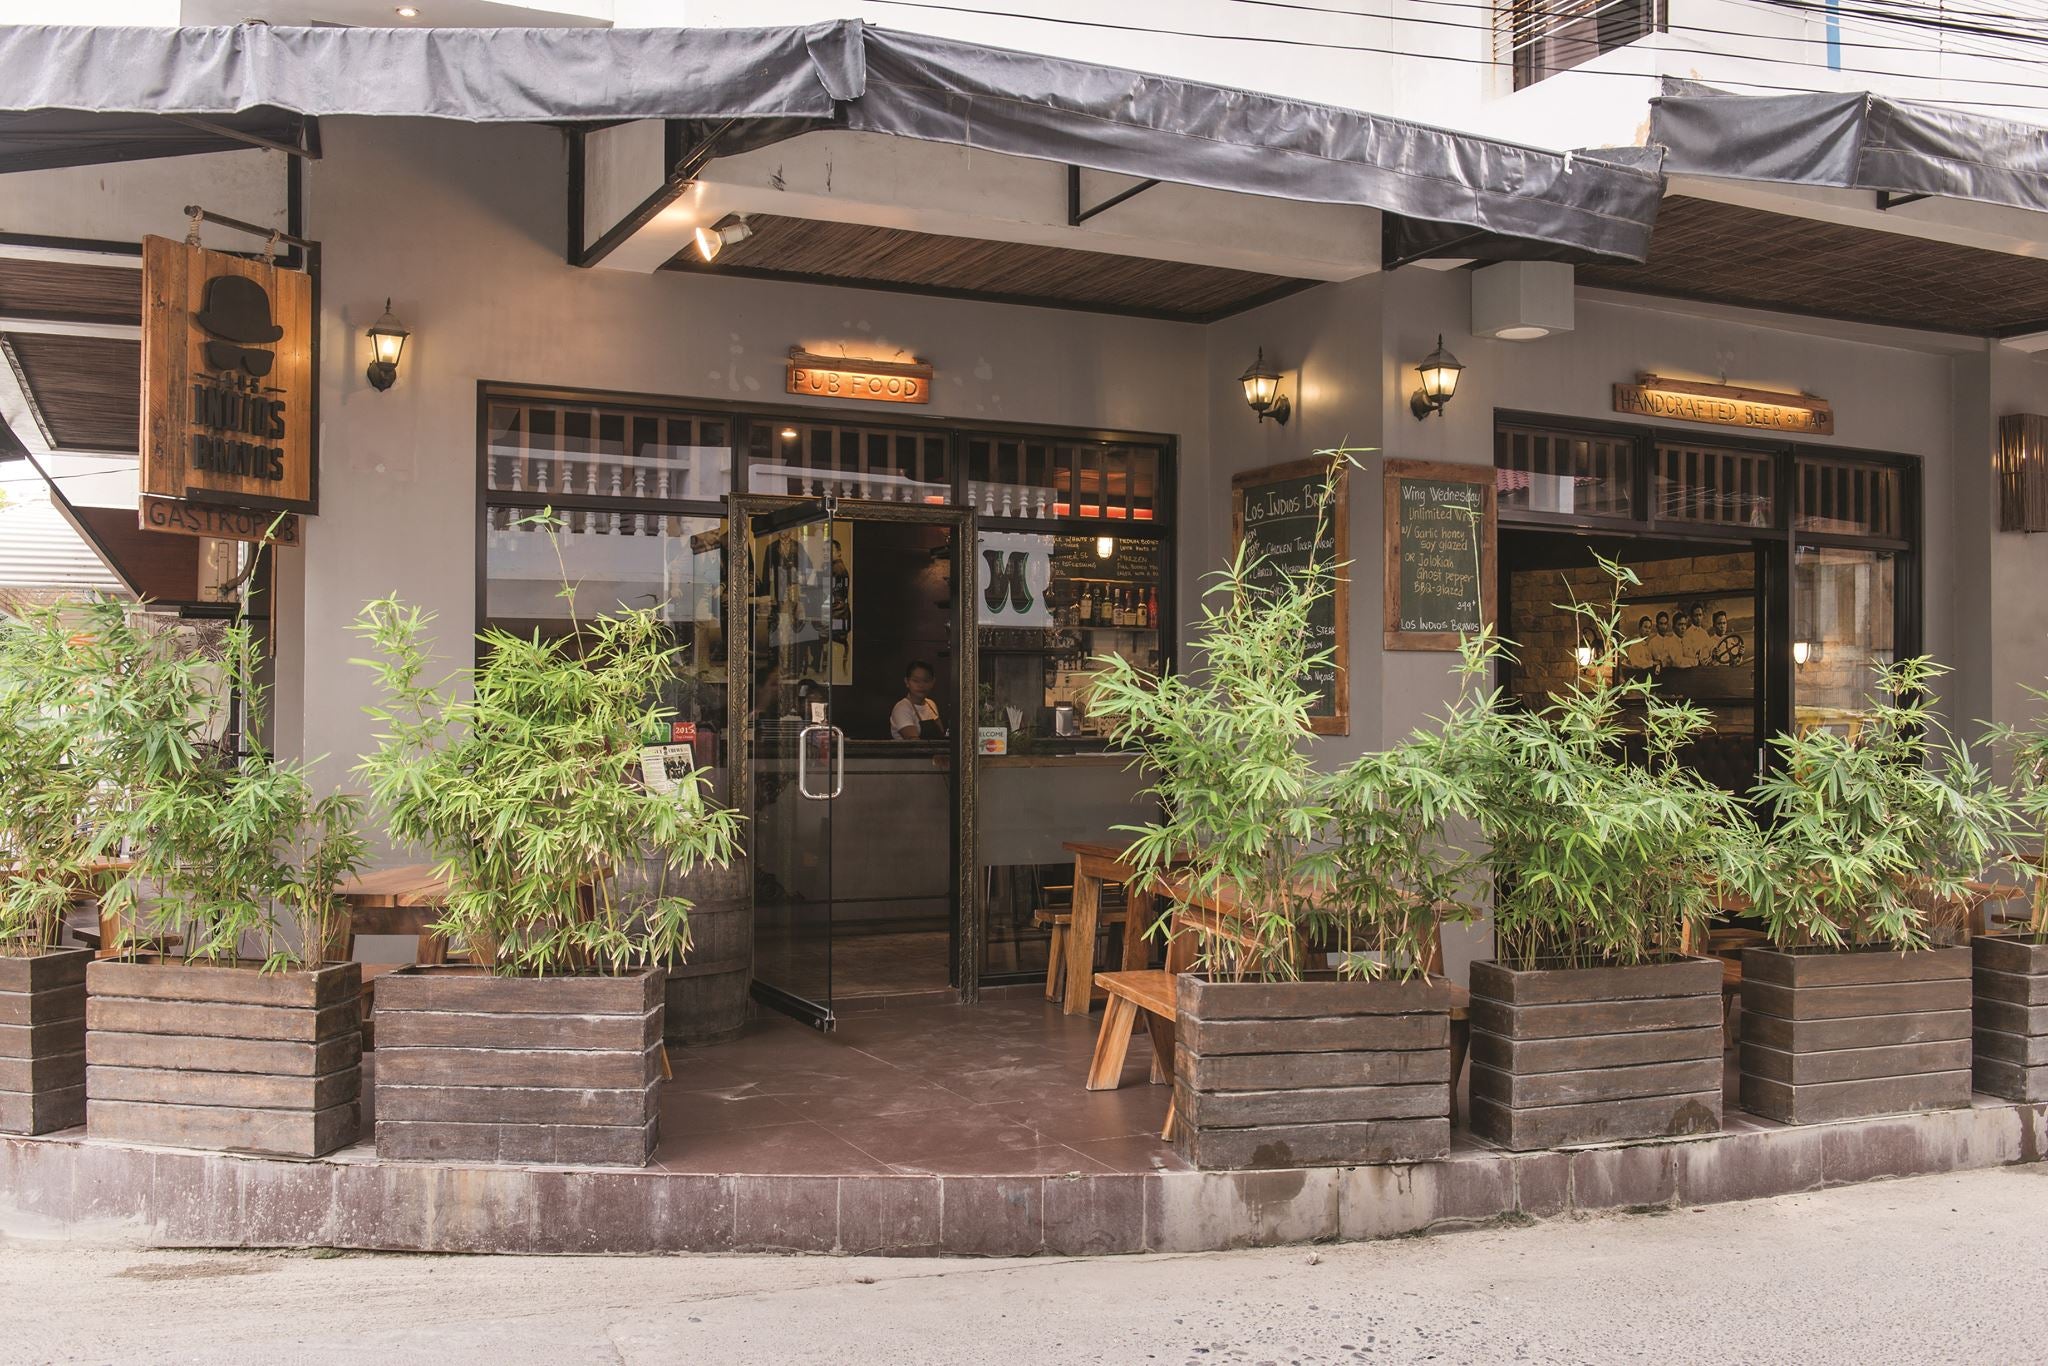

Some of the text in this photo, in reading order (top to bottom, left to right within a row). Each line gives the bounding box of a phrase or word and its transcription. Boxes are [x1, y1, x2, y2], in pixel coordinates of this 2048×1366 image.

[793, 370, 917, 398] PUB FOOD
[192, 384, 286, 440] INDIOS
[1620, 389, 1736, 422] HANDCRAFTED
[1745, 405, 1781, 427] BEER
[1801, 410, 1828, 432] TAP
[192, 434, 284, 482] BRAVOS
[1402, 485, 1480, 507] Wing Wednesday
[1409, 507, 1452, 520] Unlimited
[1414, 526, 1438, 539] Garlic
[1439, 540, 1468, 553] glazed
[1417, 567, 1474, 587] Ghost pepper
[675, 726, 695, 734] 2015
